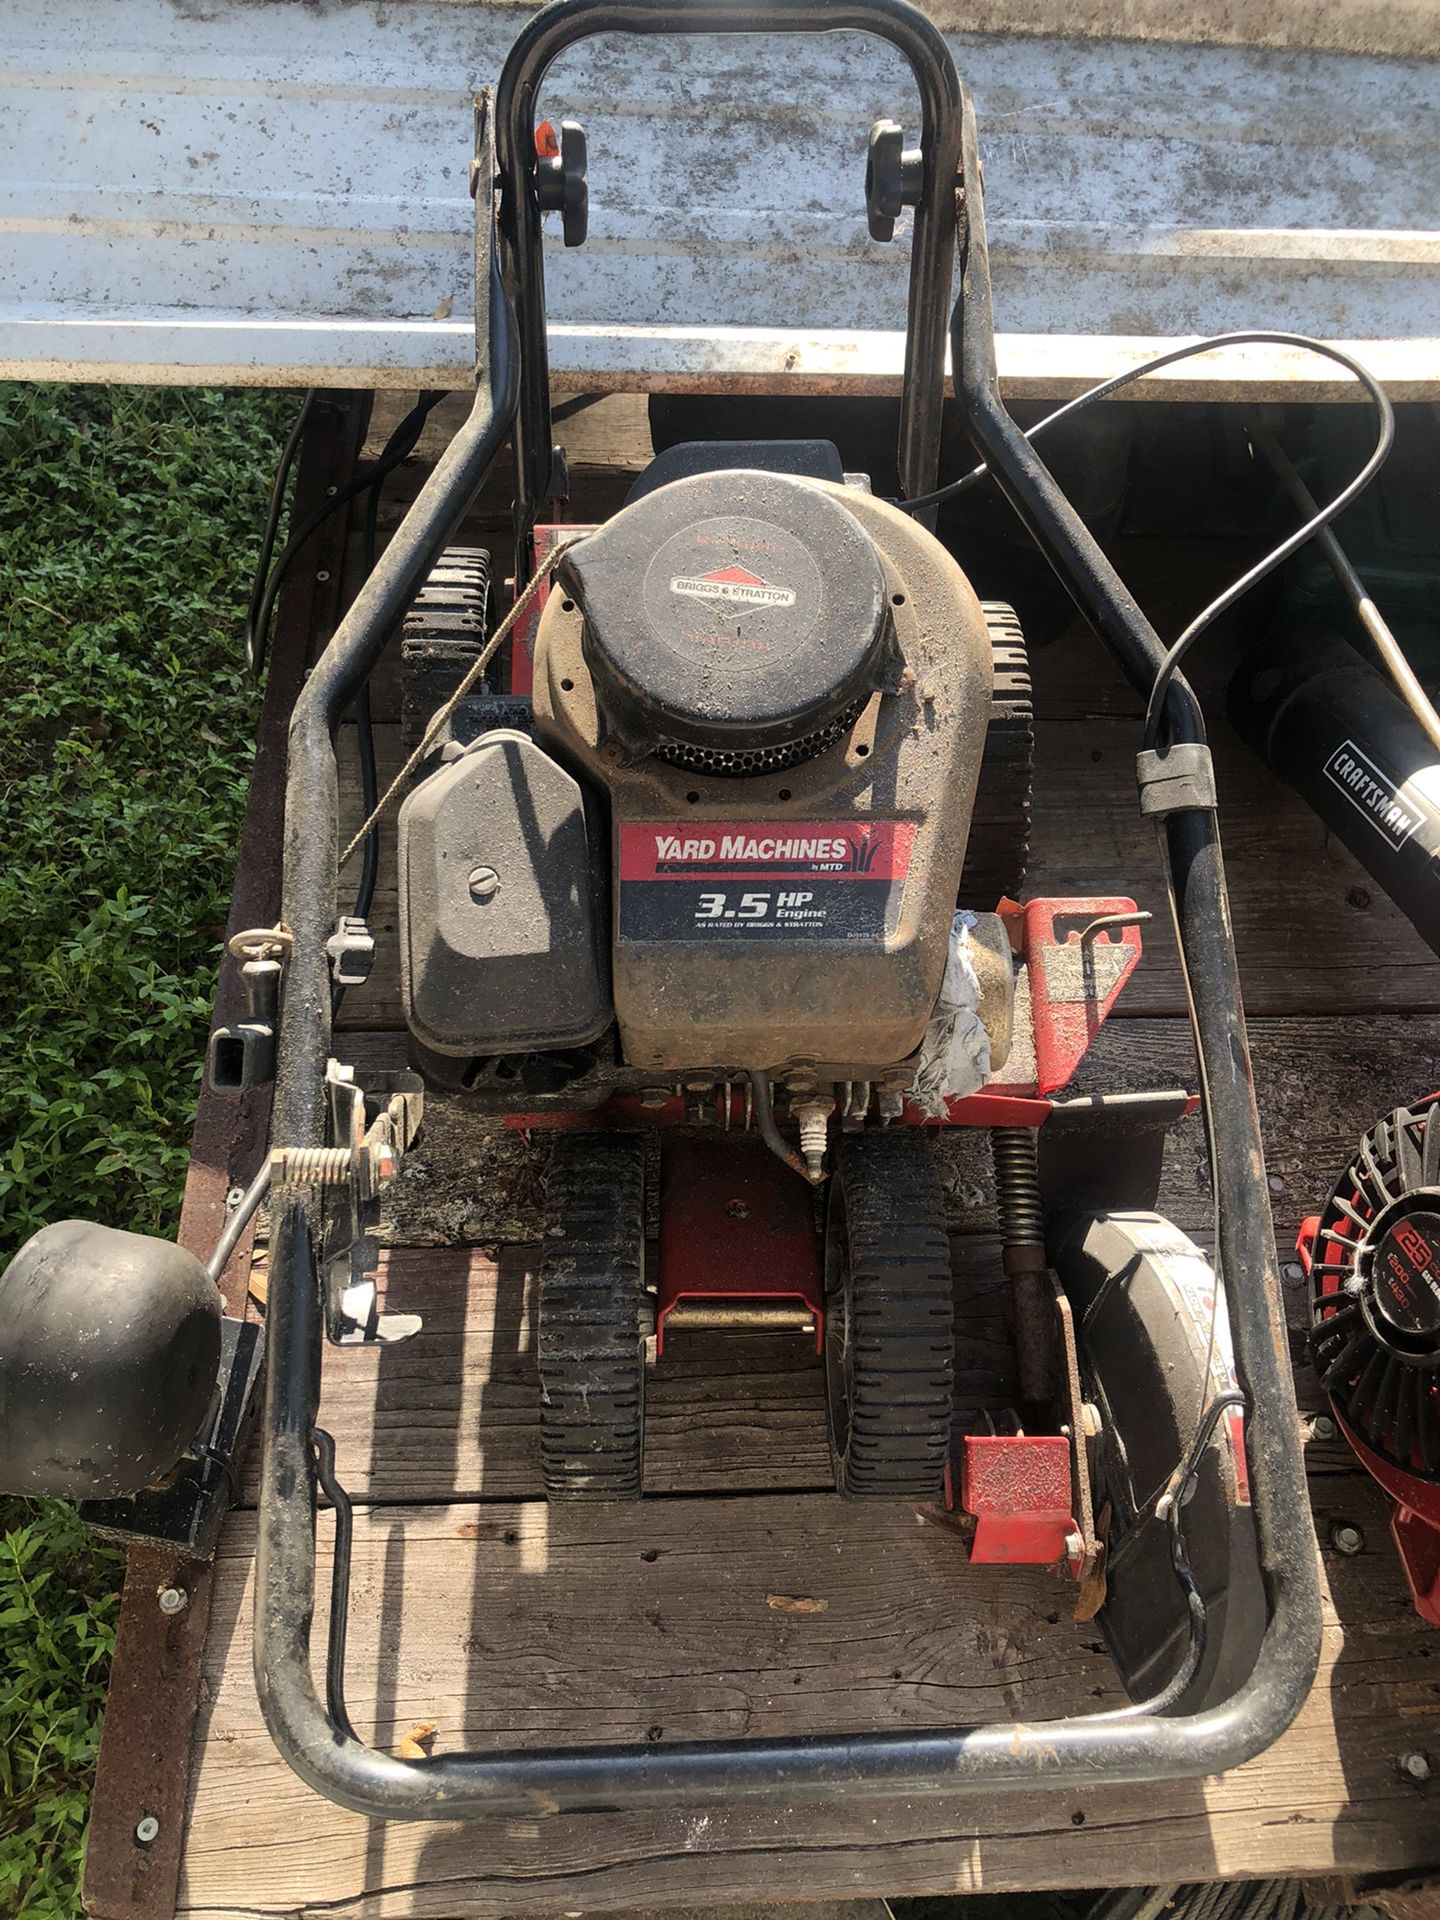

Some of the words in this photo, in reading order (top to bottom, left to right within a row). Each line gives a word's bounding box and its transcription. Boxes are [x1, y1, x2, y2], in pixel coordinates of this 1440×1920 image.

[676, 580, 719, 594] BRIGGS
[732, 588, 789, 602] STRATTON
[1333, 753, 1411, 836] CRAFTSMAN
[655, 836, 716, 860] YARD
[719, 836, 847, 860] MACHINES
[819, 863, 844, 871] MTD
[694, 893, 771, 919] 3.5
[776, 892, 813, 907] HP
[776, 908, 827, 920] Engine
[695, 921, 706, 929] AS
[708, 921, 733, 929] RATED
[734, 921, 745, 929] BY
[746, 921, 774, 929] BRIGGS
[784, 921, 824, 929] STRATTON
[1400, 1229, 1432, 1270] 25
[1389, 1258, 1410, 1284] 200
